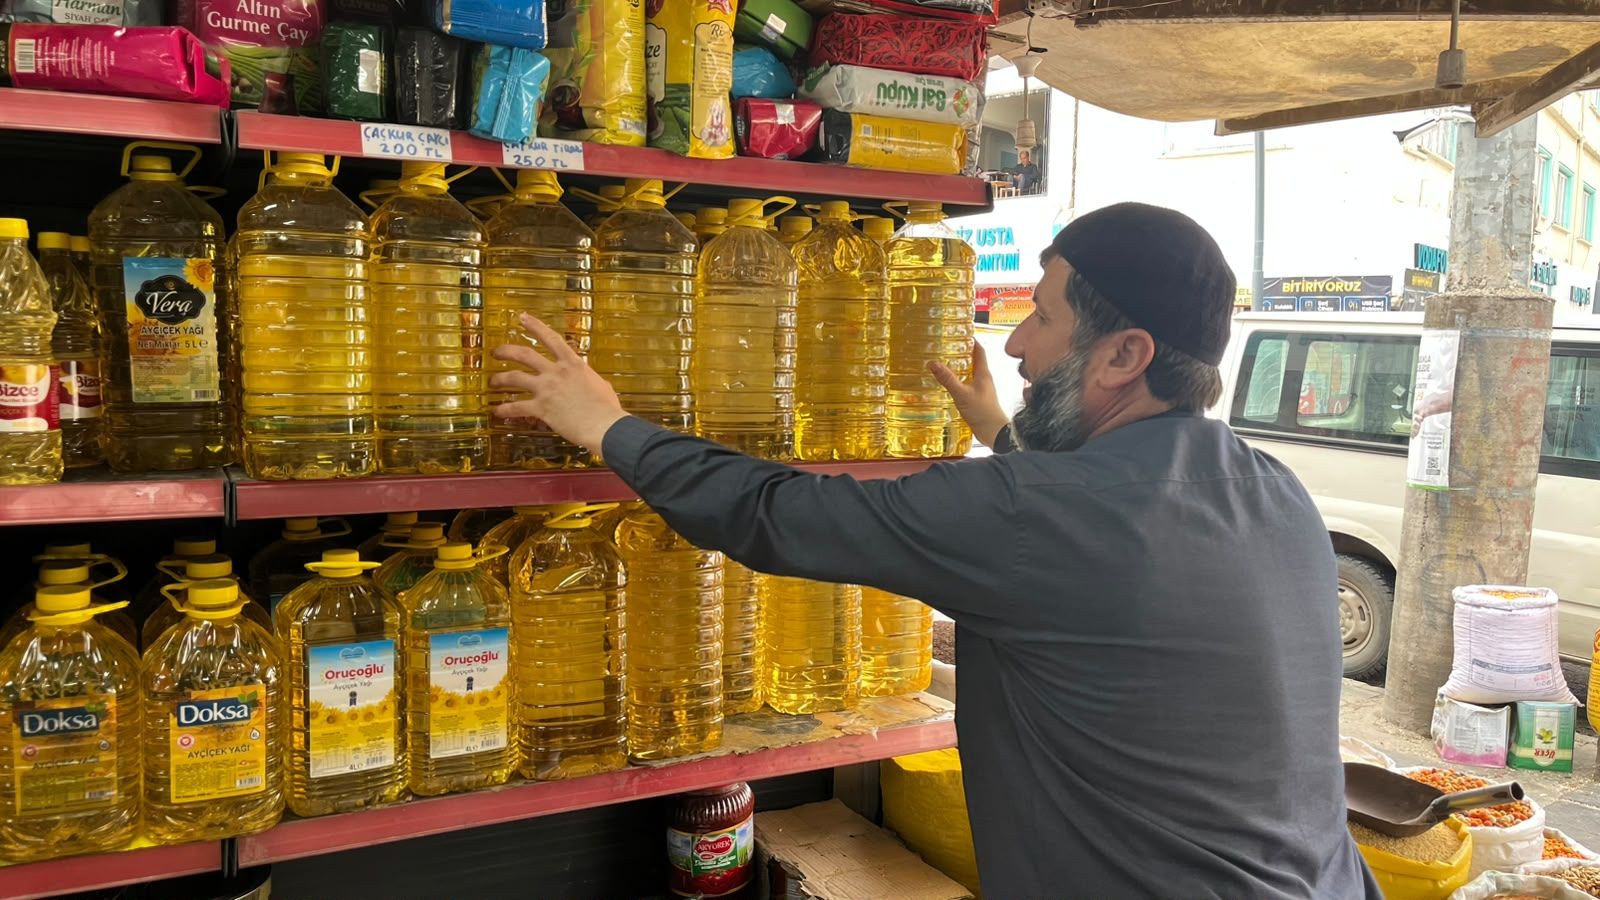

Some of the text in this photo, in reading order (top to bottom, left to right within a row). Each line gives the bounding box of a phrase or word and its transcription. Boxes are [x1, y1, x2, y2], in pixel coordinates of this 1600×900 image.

[236, 0, 281, 19] Altın
[206, 11, 309, 46] Gurme Çay
[875, 80, 918, 109] Küpü
[921, 87, 947, 112] Bal
[380, 143, 442, 157] 200 TL
[513, 154, 568, 168] 250 TL
[976, 227, 1014, 246] USTA
[1414, 243, 1448, 274] VODAFO
[1282, 279, 1361, 293] BİTİRİYORUZ
[146, 291, 193, 316] Vera
[443, 650, 499, 667] Oruçoğlu
[324, 663, 384, 680] Oruçoğlu
[180, 701, 249, 724] Doksa
[23, 711, 97, 734] Doksa
[187, 747, 228, 760] AYÇİÇEK
